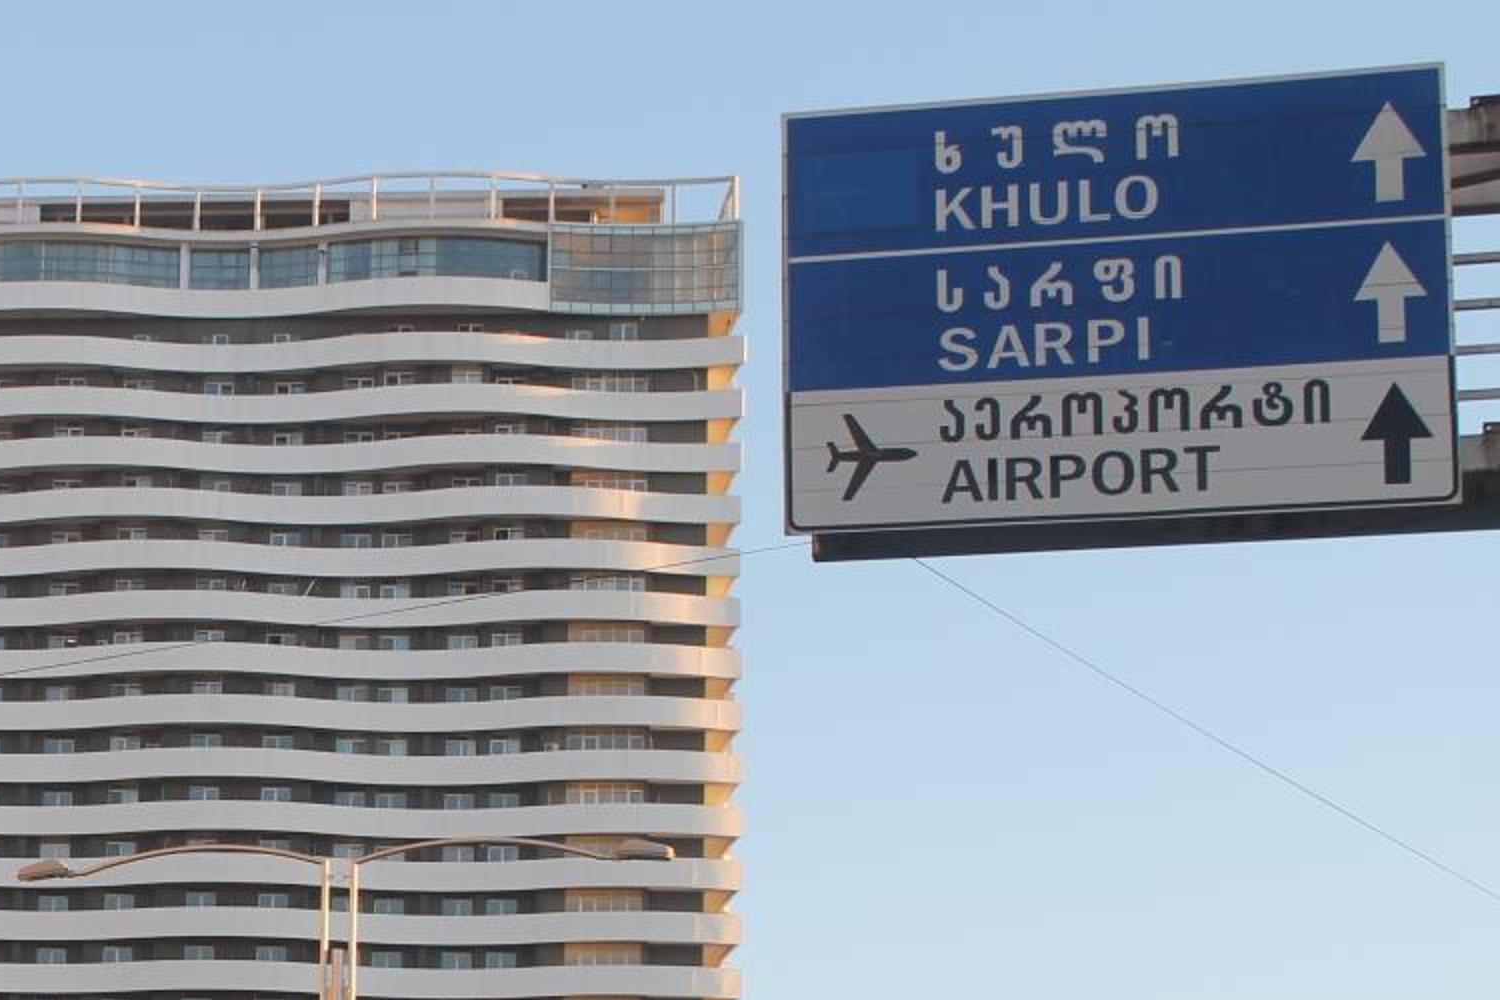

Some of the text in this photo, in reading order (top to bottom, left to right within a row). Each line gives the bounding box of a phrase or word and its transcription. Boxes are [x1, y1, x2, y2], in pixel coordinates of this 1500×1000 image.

[935, 113, 1179, 174] ხულო
[935, 175, 1159, 231] KHULO
[937, 255, 1182, 313] სარფი
[938, 316, 1150, 371] SARPI
[939, 378, 1331, 443] აეროპორტი
[941, 445, 1221, 504] AIRPORT
